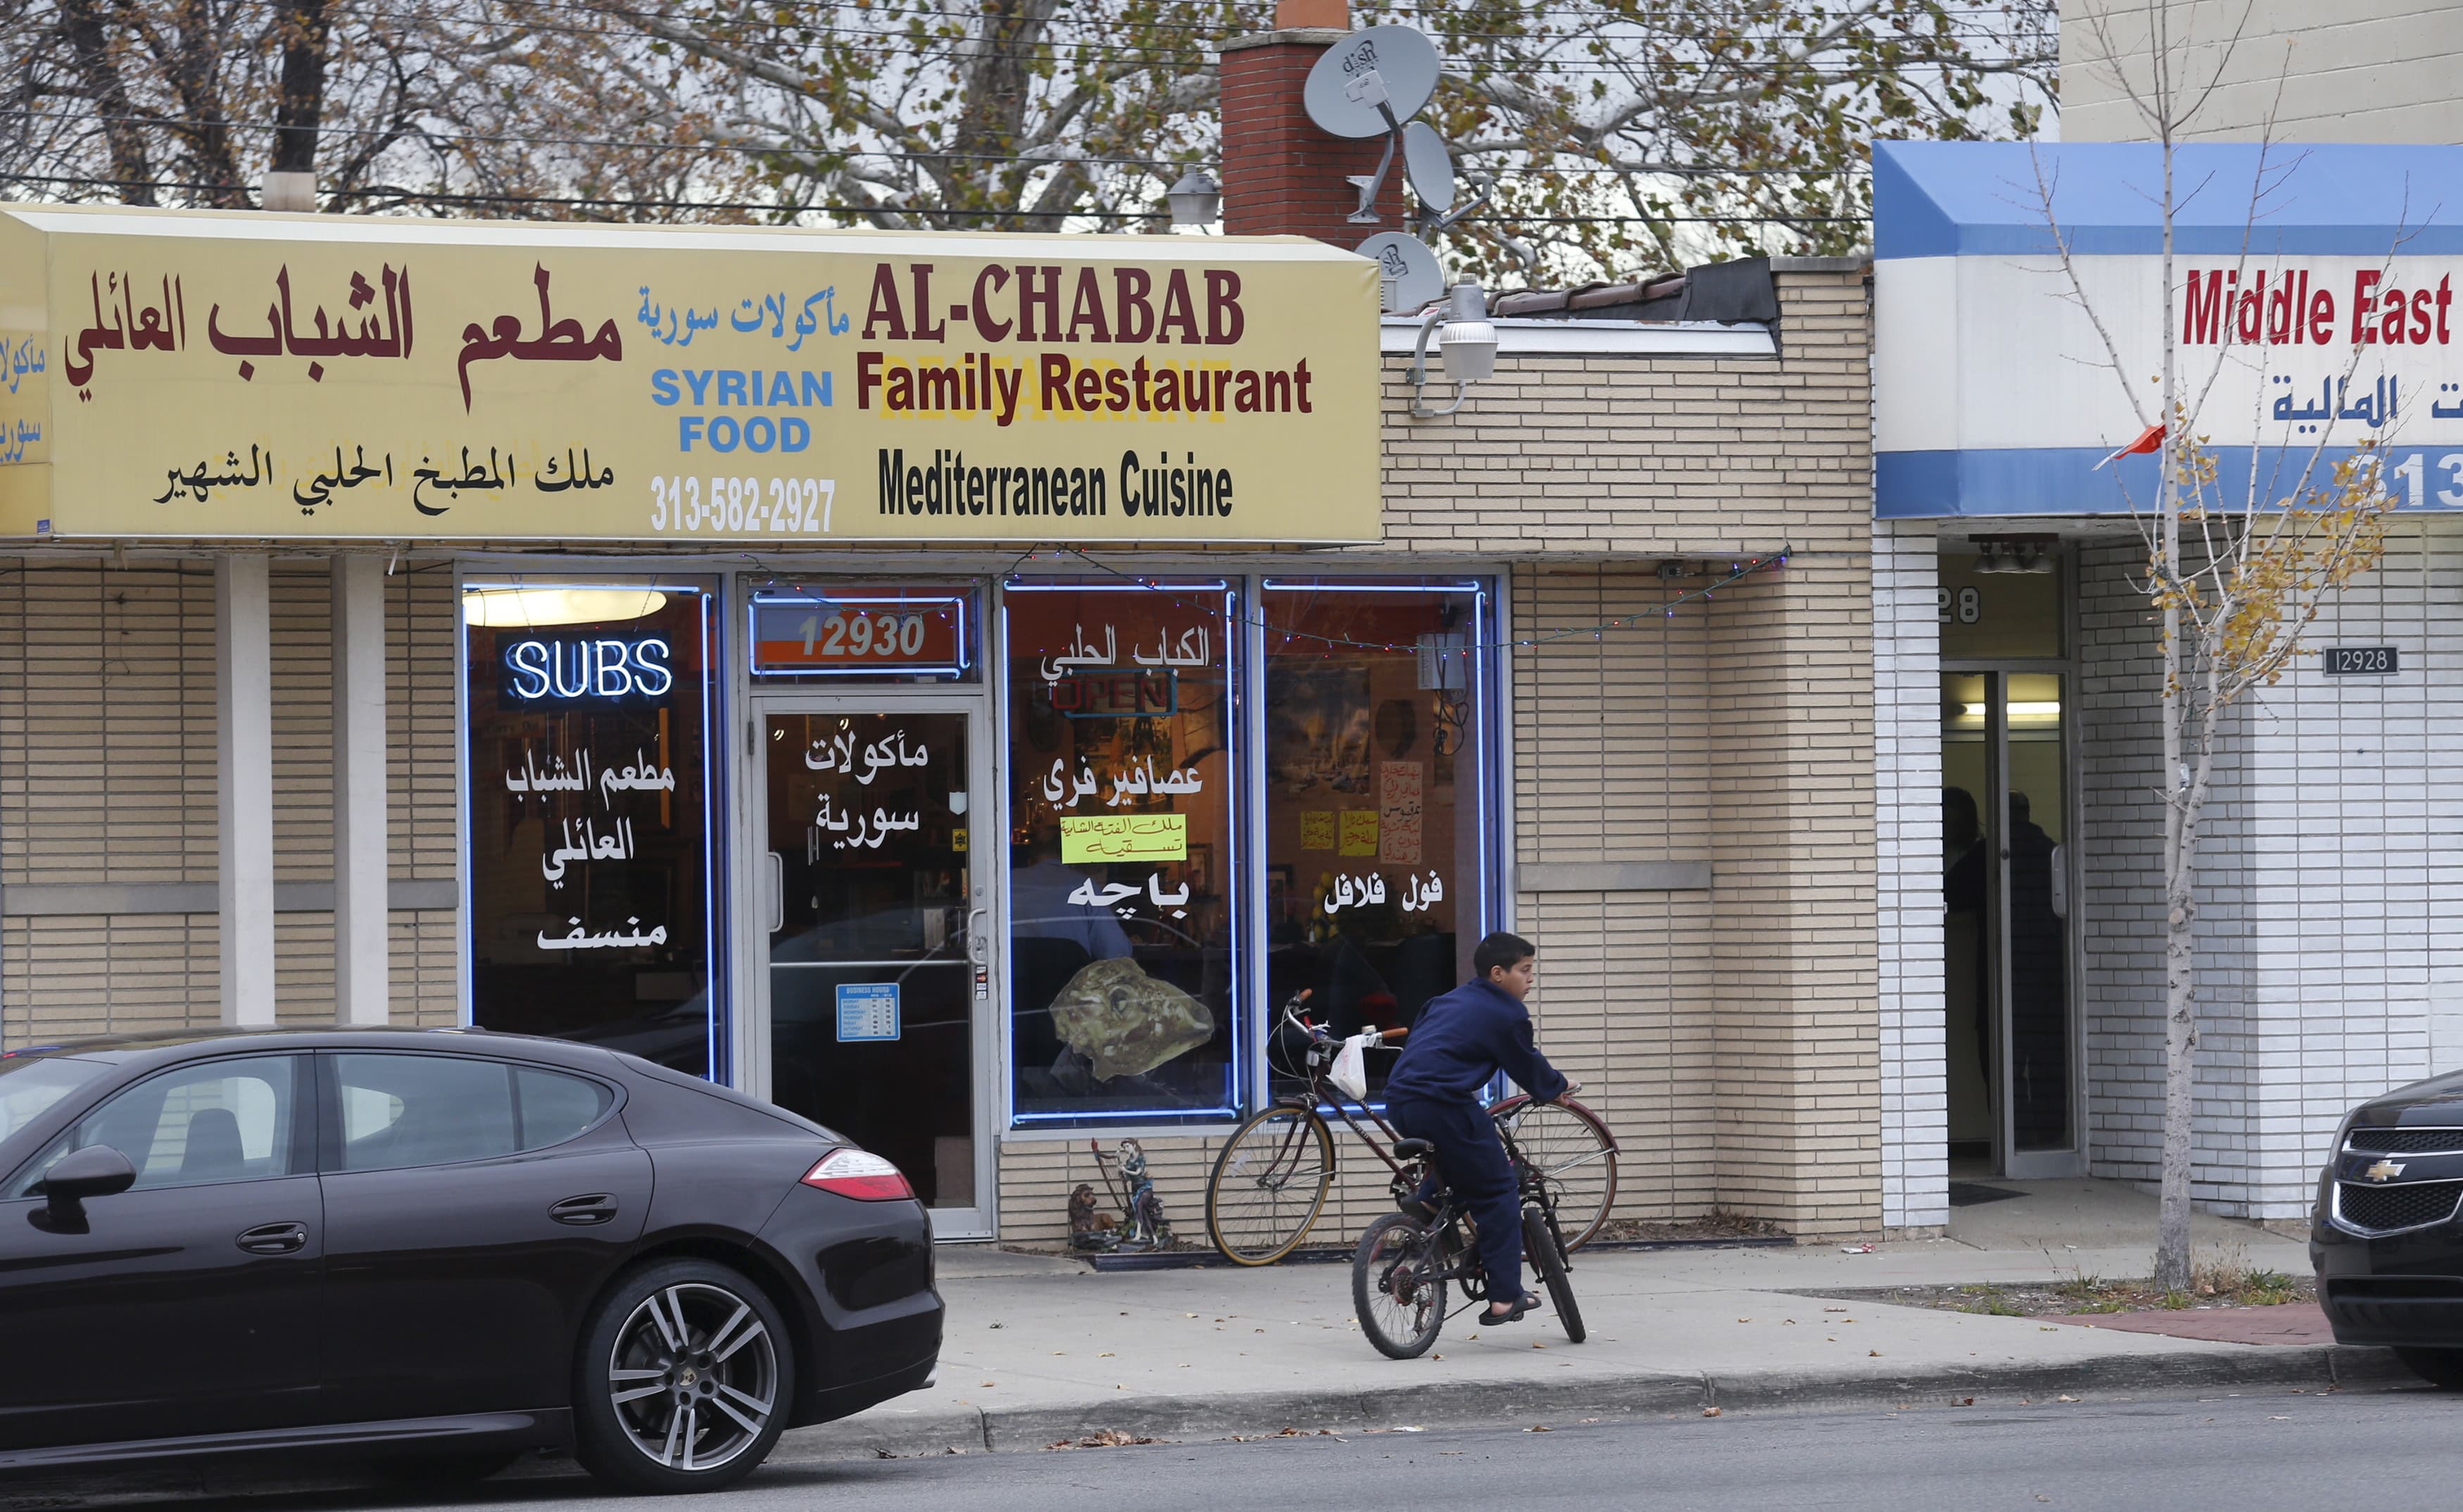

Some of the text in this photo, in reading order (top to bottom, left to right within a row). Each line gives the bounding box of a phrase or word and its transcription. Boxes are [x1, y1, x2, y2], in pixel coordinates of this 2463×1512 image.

[637, 286, 849, 352] مأكولات سورية
[862, 263, 1245, 345] AL-CHABAB
[2184, 269, 2452, 345] Middle East
[65, 261, 622, 414] مطعم الشباب العائلي
[652, 369, 832, 407] SYRIAN
[857, 352, 1312, 427] Family Restaurant
[2274, 374, 2397, 433] المالية
[679, 416, 811, 453] FOOD
[153, 443, 273, 504] الشهير
[293, 444, 393, 516] الحلبي
[413, 446, 516, 516] المطبخ
[535, 447, 614, 492] ملك
[878, 448, 1233, 517] Mediterranean Cuisine
[650, 476, 836, 533] 313-582-2927
[799, 615, 925, 656] 12930
[1041, 623, 1209, 688] الكباب الحلبي
[2336, 650, 2388, 671] 12928
[513, 639, 673, 699] SUBS
[1053, 678, 1167, 709] OPEN
[505, 748, 676, 811] مطعم الشباب
[805, 730, 928, 785] مأكولات
[1044, 754, 1203, 811] عصافير فري
[816, 793, 919, 849] سورية
[1132, 818, 1182, 834] ملك
[543, 817, 634, 890] العائلي
[1324, 870, 1443, 915] فول فلافل
[536, 915, 668, 951] منسف
